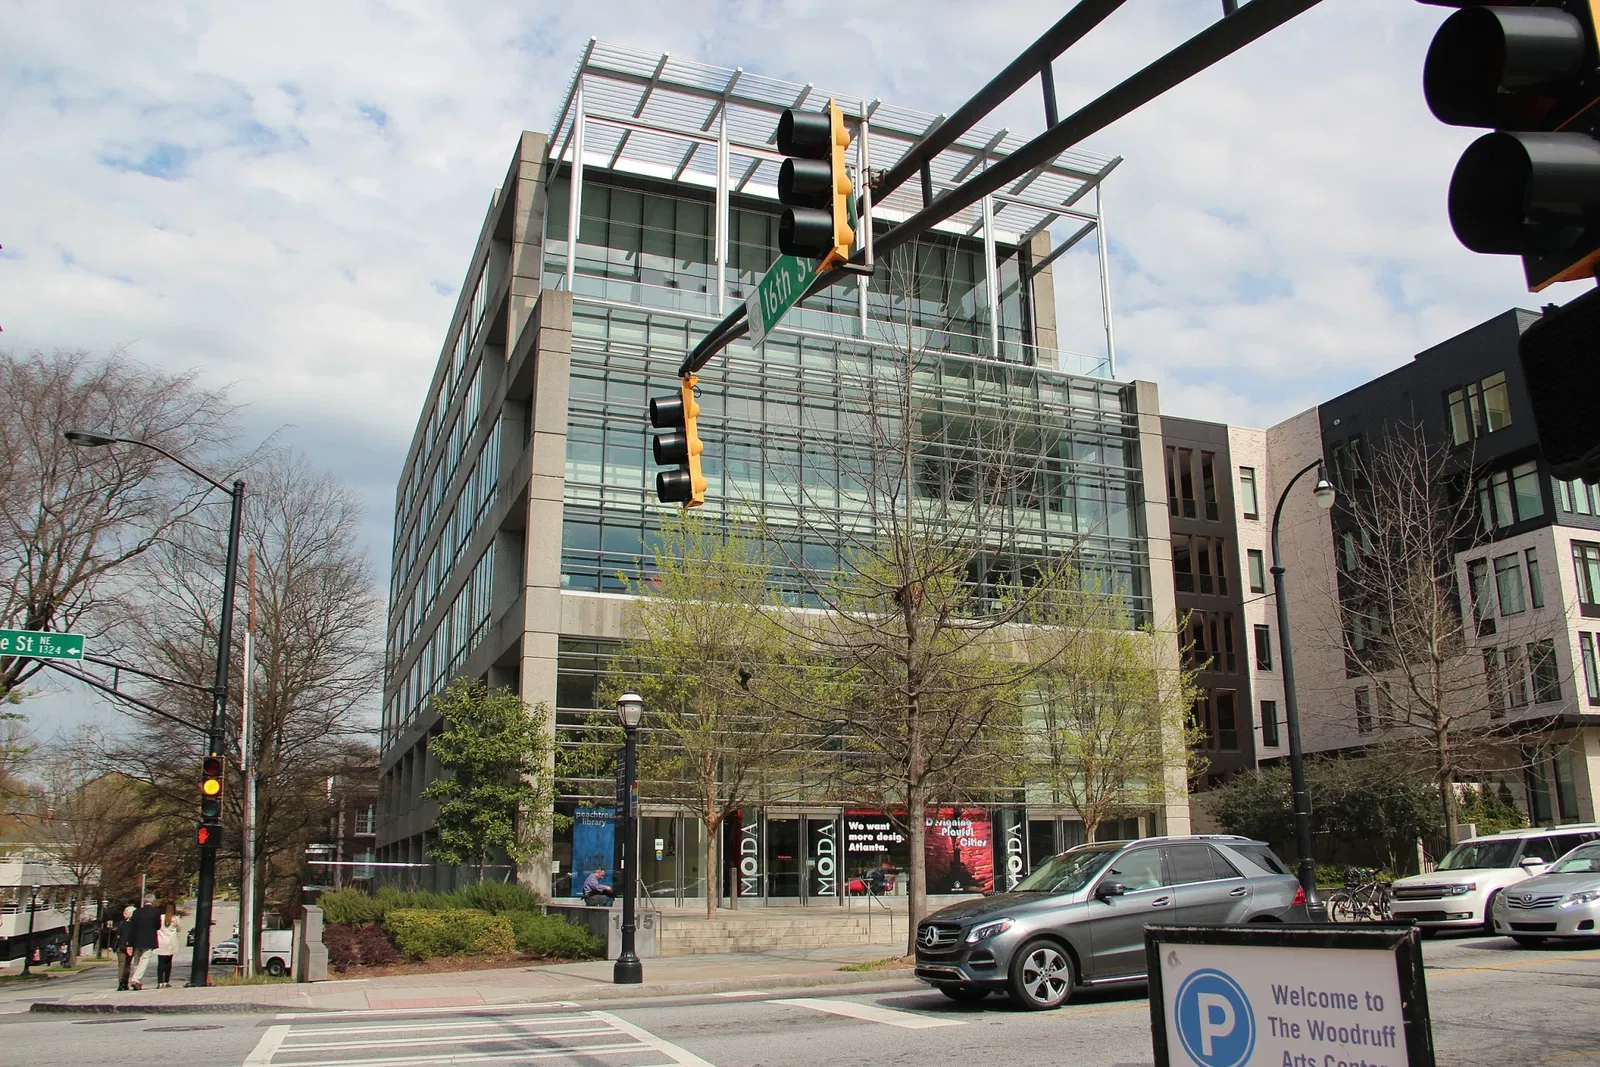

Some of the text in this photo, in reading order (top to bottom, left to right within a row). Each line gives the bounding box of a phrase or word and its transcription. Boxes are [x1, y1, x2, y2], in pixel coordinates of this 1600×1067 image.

[764, 267, 791, 320] 16th
[16, 636, 33, 652] St
[40, 637, 52, 645] NE
[39, 646, 61, 654] 1324
[582, 818, 606, 828] library
[848, 821, 891, 831] We want
[848, 832, 908, 844] more desig
[941, 827, 975, 838] Playful
[848, 842, 889, 852] Atlanta.
[960, 837, 987, 847] Cities
[740, 822, 758, 896] MODA
[817, 823, 835, 895] MODA
[1007, 821, 1024, 893] MODA
[612, 913, 654, 930] 115
[1271, 983, 1385, 1012] Welcome to
[1267, 1016, 1396, 1048] The Woodruff
